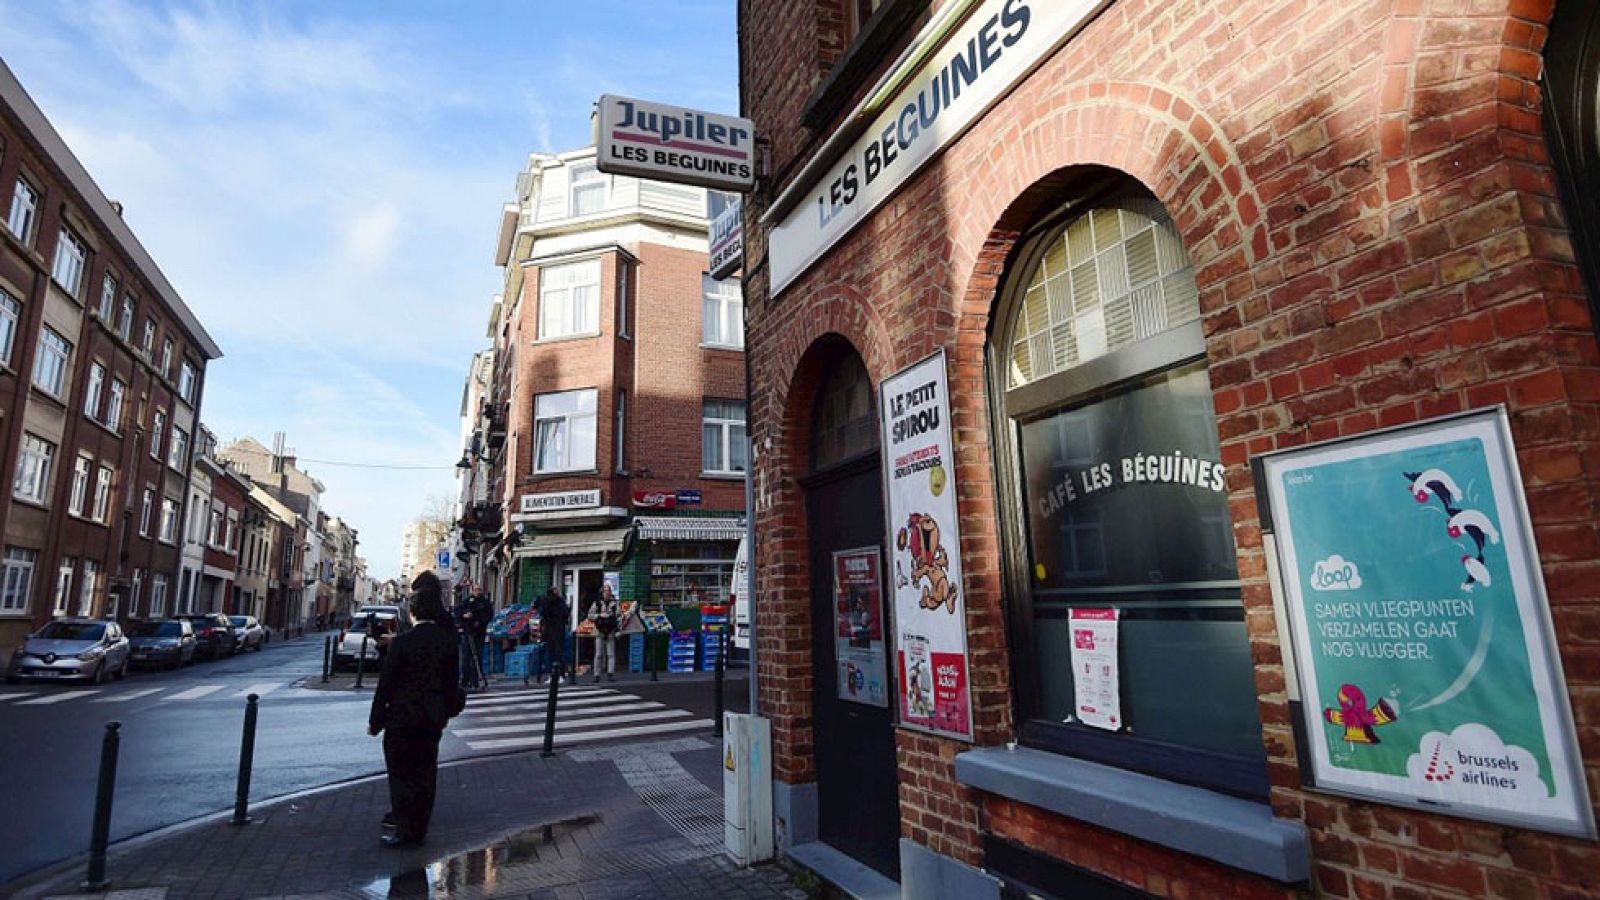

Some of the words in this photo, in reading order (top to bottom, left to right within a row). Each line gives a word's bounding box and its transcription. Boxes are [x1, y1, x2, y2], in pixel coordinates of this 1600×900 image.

[614, 101, 749, 146] Jupiler
[817, 164, 858, 229] LES
[863, 0, 1031, 187] BEGUINES
[611, 145, 648, 162] LES
[654, 151, 750, 179] BEGUINES
[889, 393, 905, 419] LE
[906, 380, 937, 410] PETIT
[892, 405, 940, 445] SPIROU
[1038, 472, 1077, 518] CAFÉ
[1081, 463, 1113, 493] LES
[1316, 564, 1353, 589] loop
[1314, 602, 1361, 618] SAMEN
[1364, 599, 1475, 617] VLIEGPUNTEN
[1318, 622, 1410, 638] VERZAMELEN
[1414, 621, 1458, 638] GAAT
[1322, 642, 1353, 657] NOG
[1457, 750, 1519, 771] brussels
[1462, 769, 1517, 789] airlines
